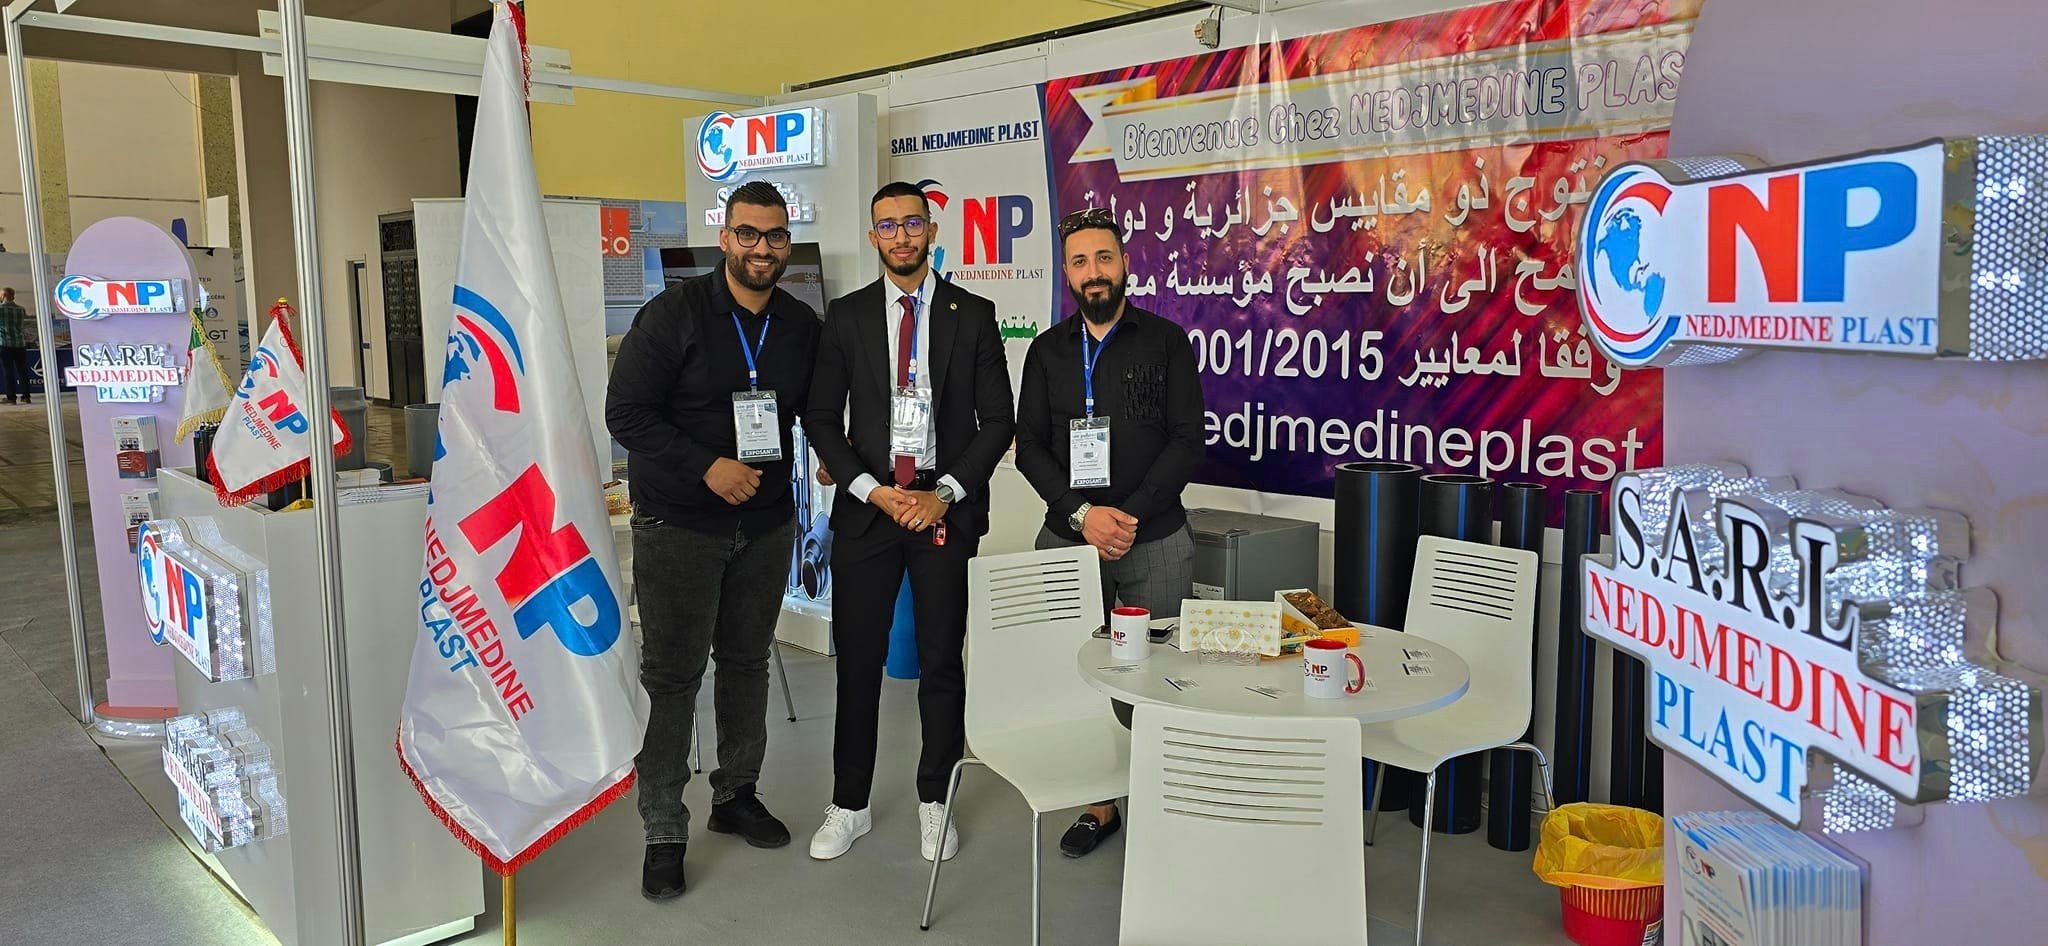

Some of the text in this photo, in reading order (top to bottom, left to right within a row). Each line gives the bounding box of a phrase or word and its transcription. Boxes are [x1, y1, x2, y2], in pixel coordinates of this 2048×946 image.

[747, 112, 804, 156] NP
[1123, 50, 1686, 161] Bienvenue Chez NEDJMEDINE PLAS
[738, 152, 810, 168] NEDJMEDINE PLAST
[891, 120, 1039, 155] SARL NEDJMEDINE PLAST
[1182, 179, 1298, 240] جزائرية
[1311, 168, 1431, 233] مقاييس
[1444, 156, 1489, 227] ذو
[963, 194, 1034, 265] NP
[1155, 205, 1174, 243] و
[1707, 161, 1918, 304] NP
[106, 282, 165, 306] NP
[953, 268, 1044, 281] NEDJMEDINE PLAST
[1166, 249, 1273, 308] مؤسسة
[1286, 250, 1374, 317] نصبح
[1386, 237, 1427, 307] أن
[79, 346, 160, 367] S.A.R.L
[1398, 328, 1523, 389] لمعايير
[1684, 314, 1938, 348] NEDJMEDINE PLAST
[67, 368, 178, 384] NEDJMEDINE
[98, 385, 151, 400] PLAST
[242, 401, 282, 451] NEDJMEDINE
[242, 416, 264, 440] PLAST
[258, 388, 309, 435] NP
[1204, 401, 1644, 482] edjmedineplast
[457, 462, 622, 657] NP
[1617, 486, 1860, 653] S.A.R.L
[164, 555, 203, 641] NP
[419, 577, 480, 673] PLAST
[425, 515, 535, 721] NEDJMEDINE
[1113, 630, 1126, 640] NP
[1311, 664, 1328, 675] NP
[1588, 570, 1915, 776] NEDJMEDINE
[1653, 670, 1804, 805] PLAST
